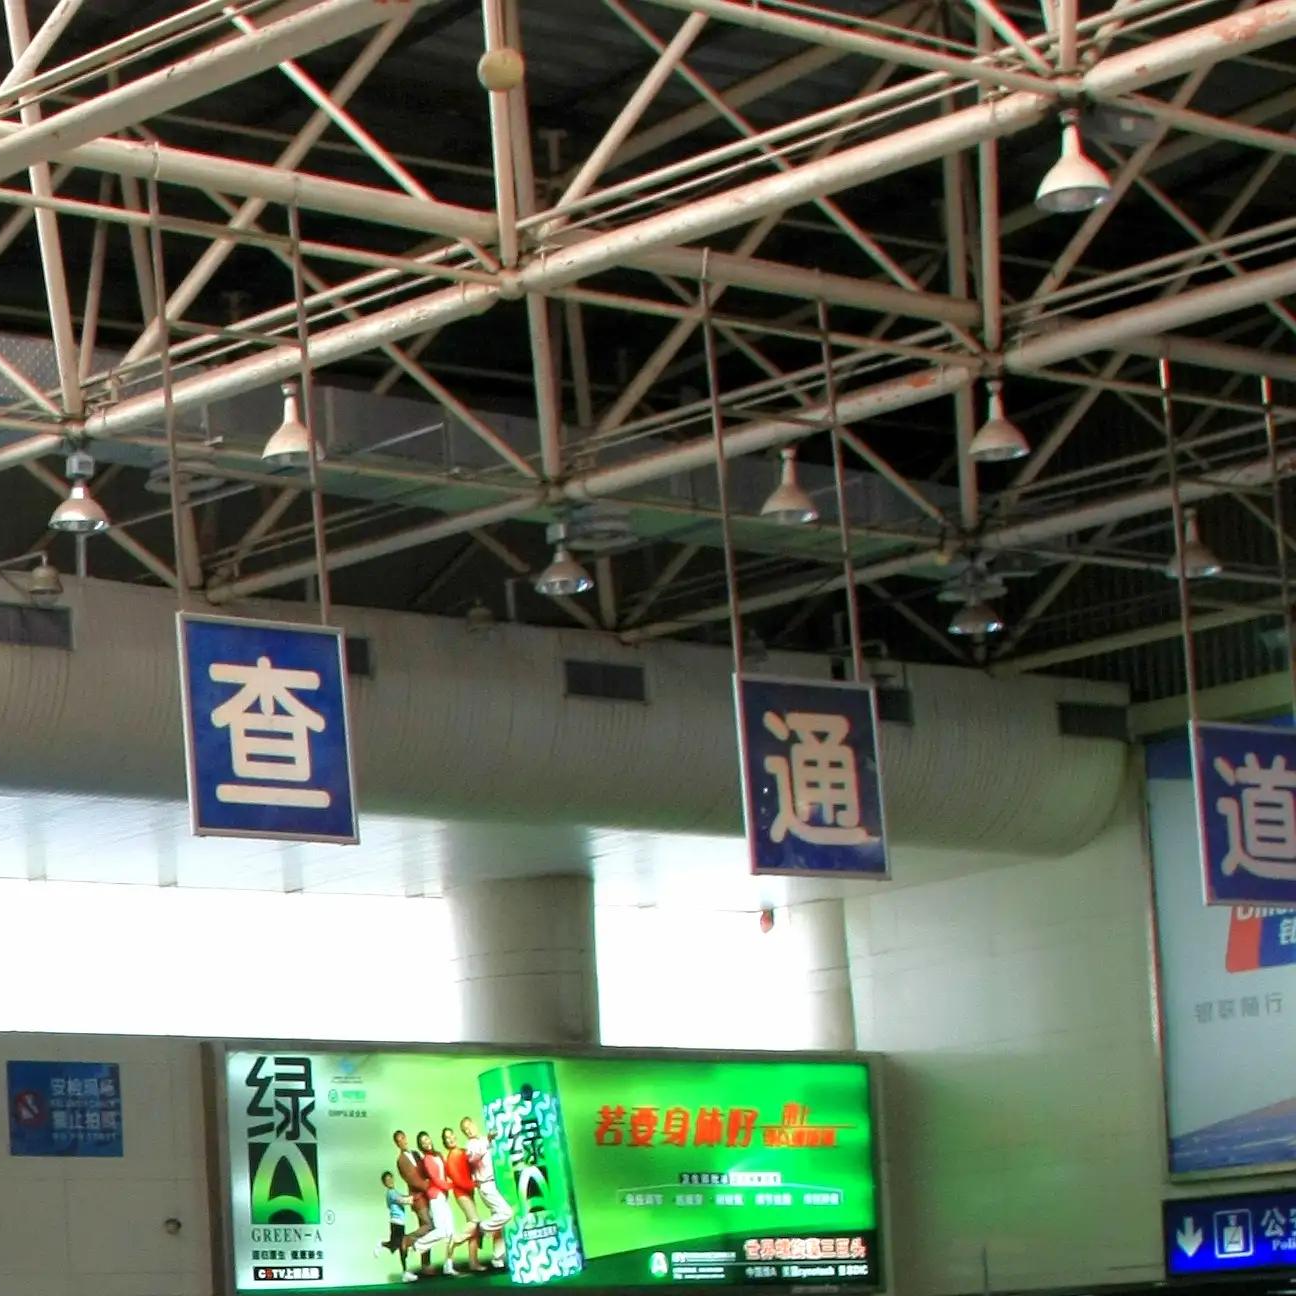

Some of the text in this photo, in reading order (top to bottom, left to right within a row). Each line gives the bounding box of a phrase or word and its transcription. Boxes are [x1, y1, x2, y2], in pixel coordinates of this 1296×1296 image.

[208, 655, 331, 808] 查
[762, 709, 882, 846] 通
[1214, 752, 1296, 882] 道
[245, 1056, 318, 1141] 绿
[251, 1227, 323, 1243] GREEN-A
[1260, 1207, 1296, 1238] 公
